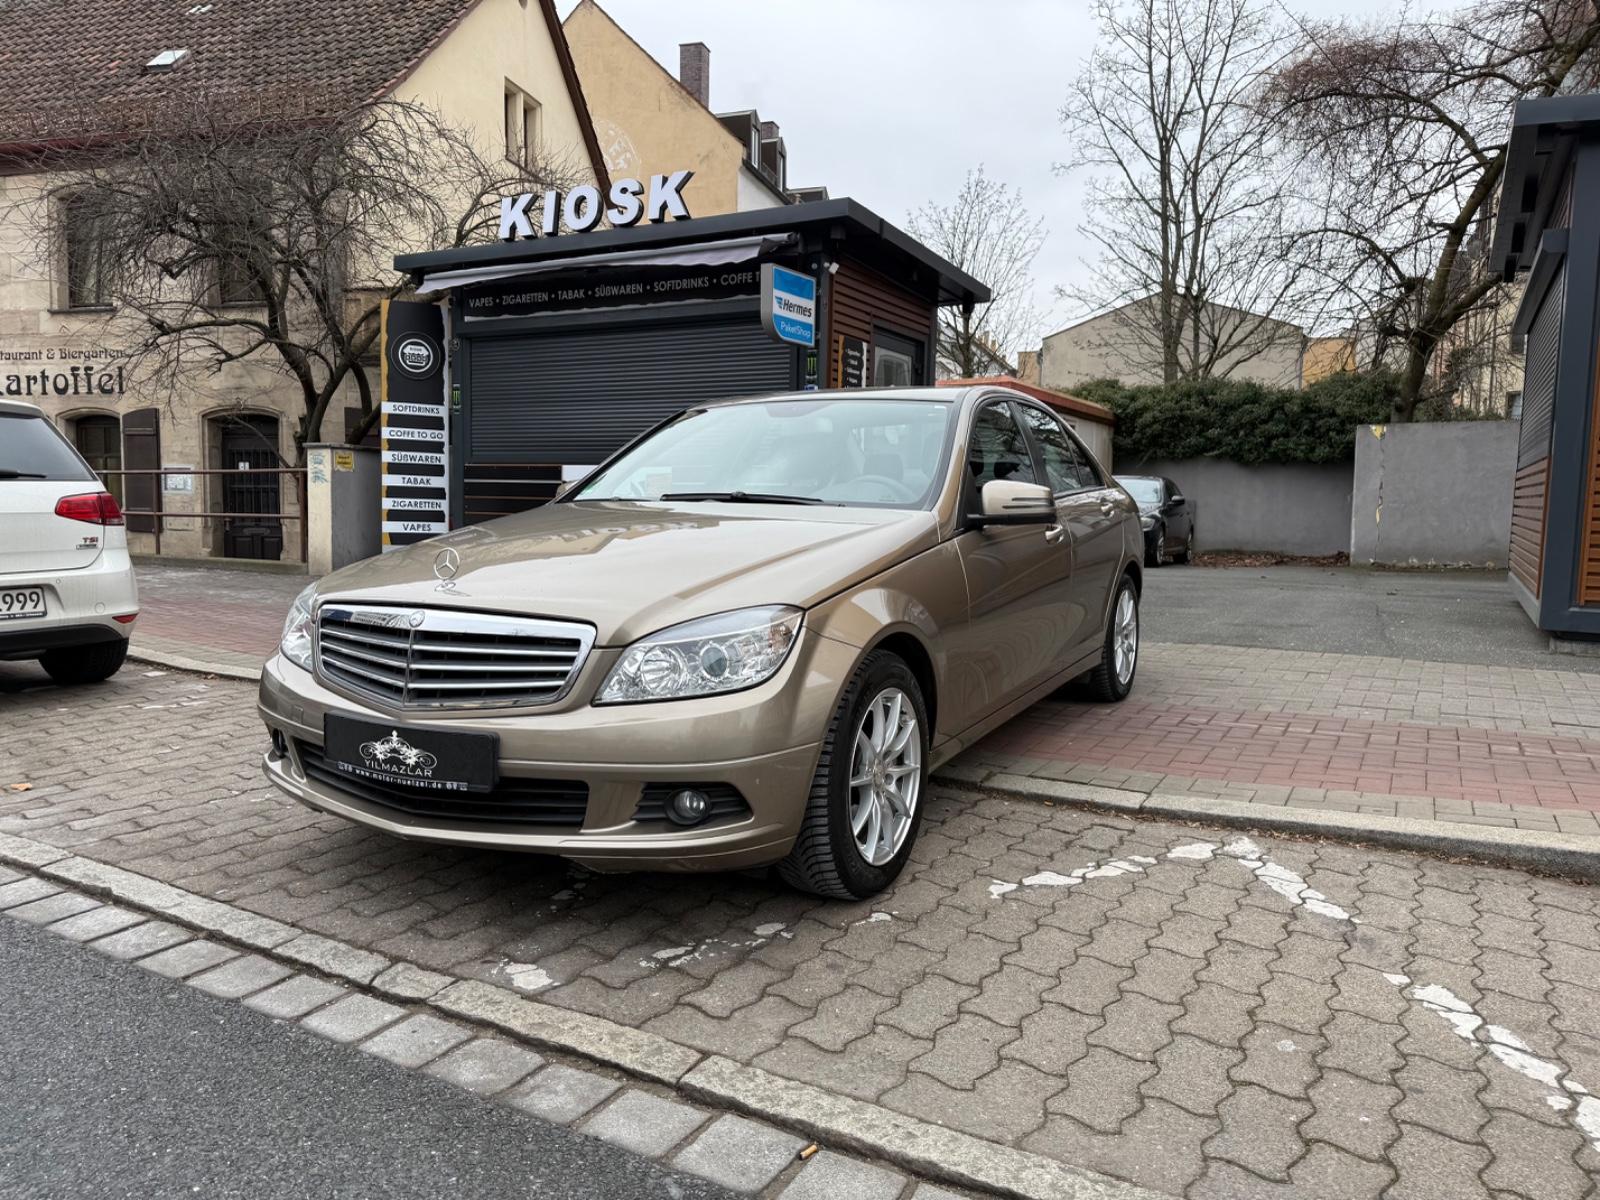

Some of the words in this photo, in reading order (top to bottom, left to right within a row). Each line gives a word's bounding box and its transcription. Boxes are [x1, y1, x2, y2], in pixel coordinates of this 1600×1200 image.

[499, 171, 694, 242] KIOSK
[469, 296, 494, 308] VAPES
[502, 292, 549, 305] ZIGARETTEN
[558, 288, 585, 300] TABAK
[654, 276, 709, 292] SOFTDRINKS
[720, 273, 753, 286] COFFE
[783, 299, 812, 318] Hermes
[780, 321, 811, 339] PaketShop
[46, 348, 55, 360] &
[58, 347, 123, 361] Biergarten
[0, 366, 125, 396] artoffel
[392, 404, 440, 415] SOFTDRINKS
[388, 429, 416, 438] COFFE
[417, 430, 428, 439] TO
[429, 432, 444, 440] GO
[401, 476, 432, 486] TABAK
[391, 499, 442, 509] ZIGARETTEN
[402, 523, 432, 532] VAPES
[0, 590, 41, 612] 999
[364, 758, 433, 778] YILMAZLAR
